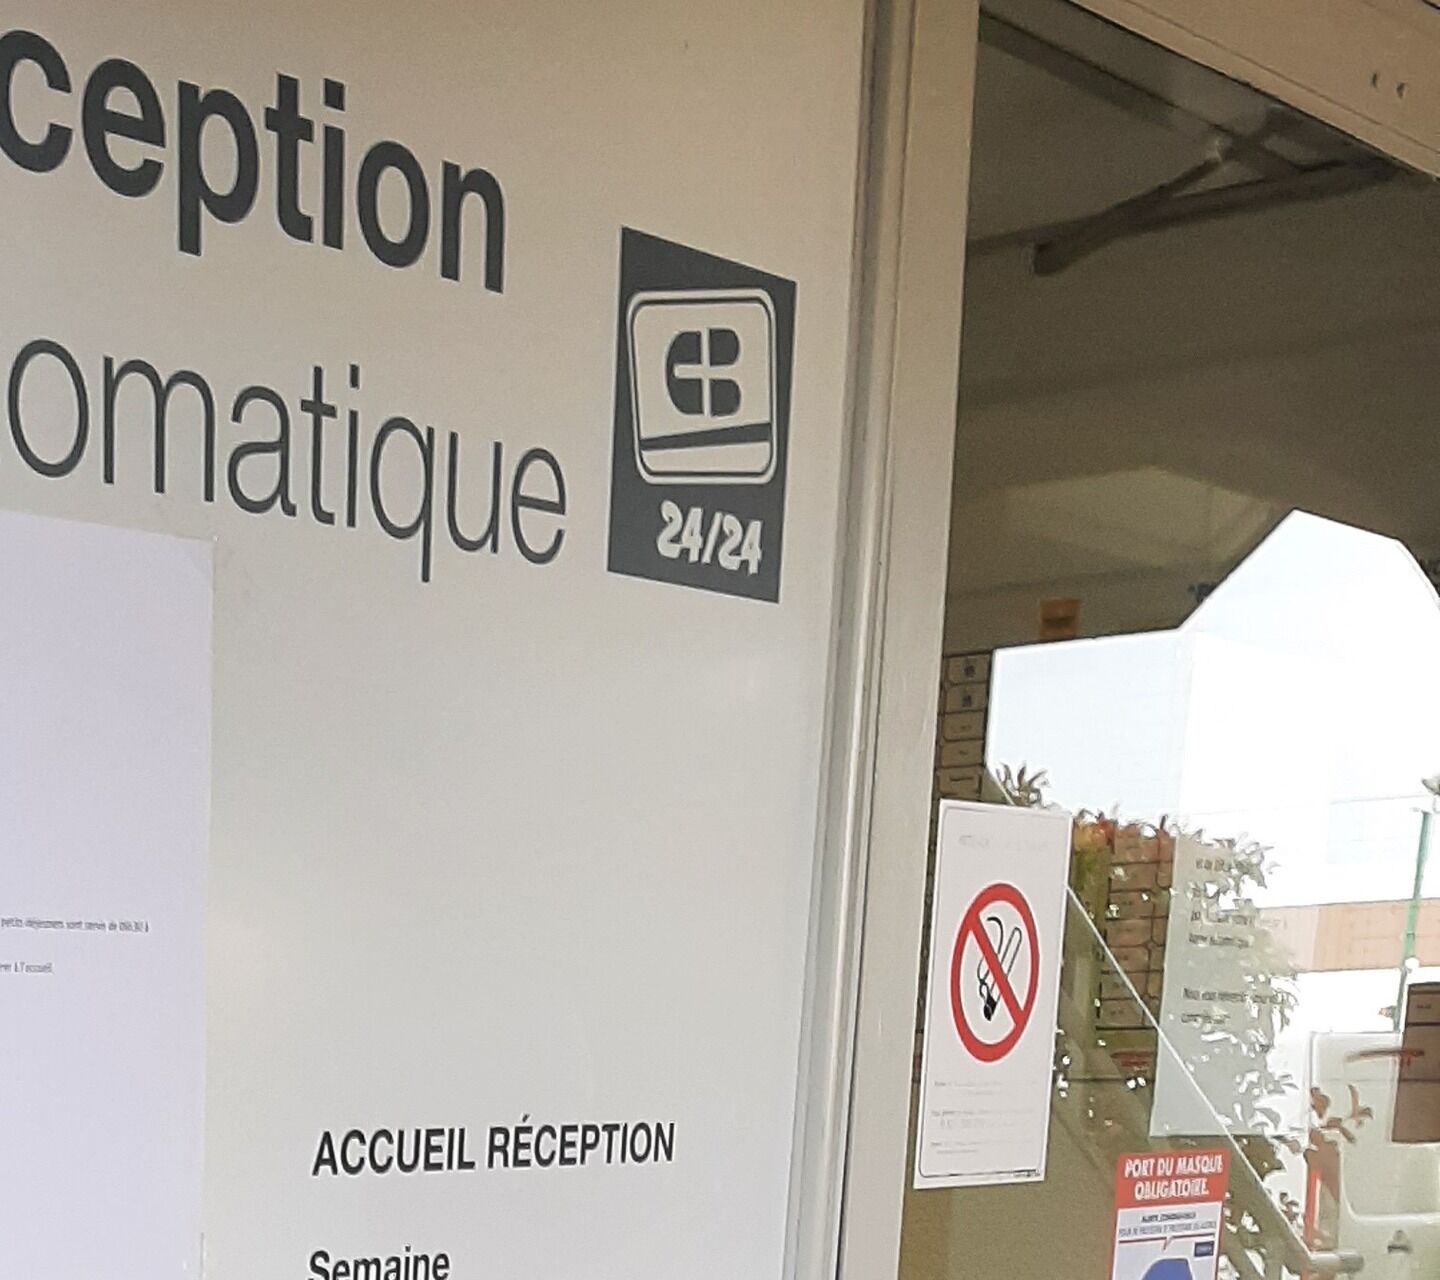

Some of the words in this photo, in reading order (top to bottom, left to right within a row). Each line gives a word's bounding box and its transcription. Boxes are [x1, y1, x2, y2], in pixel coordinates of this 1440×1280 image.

[657, 500, 763, 577] 24/24
[312, 1126, 476, 1176] ACCUEIL
[487, 1114, 676, 1169] RÉCEPTION
[1124, 1159, 1156, 1178] PORT
[1157, 1157, 1174, 1176] DU
[1176, 1154, 1224, 1175] MASQUE
